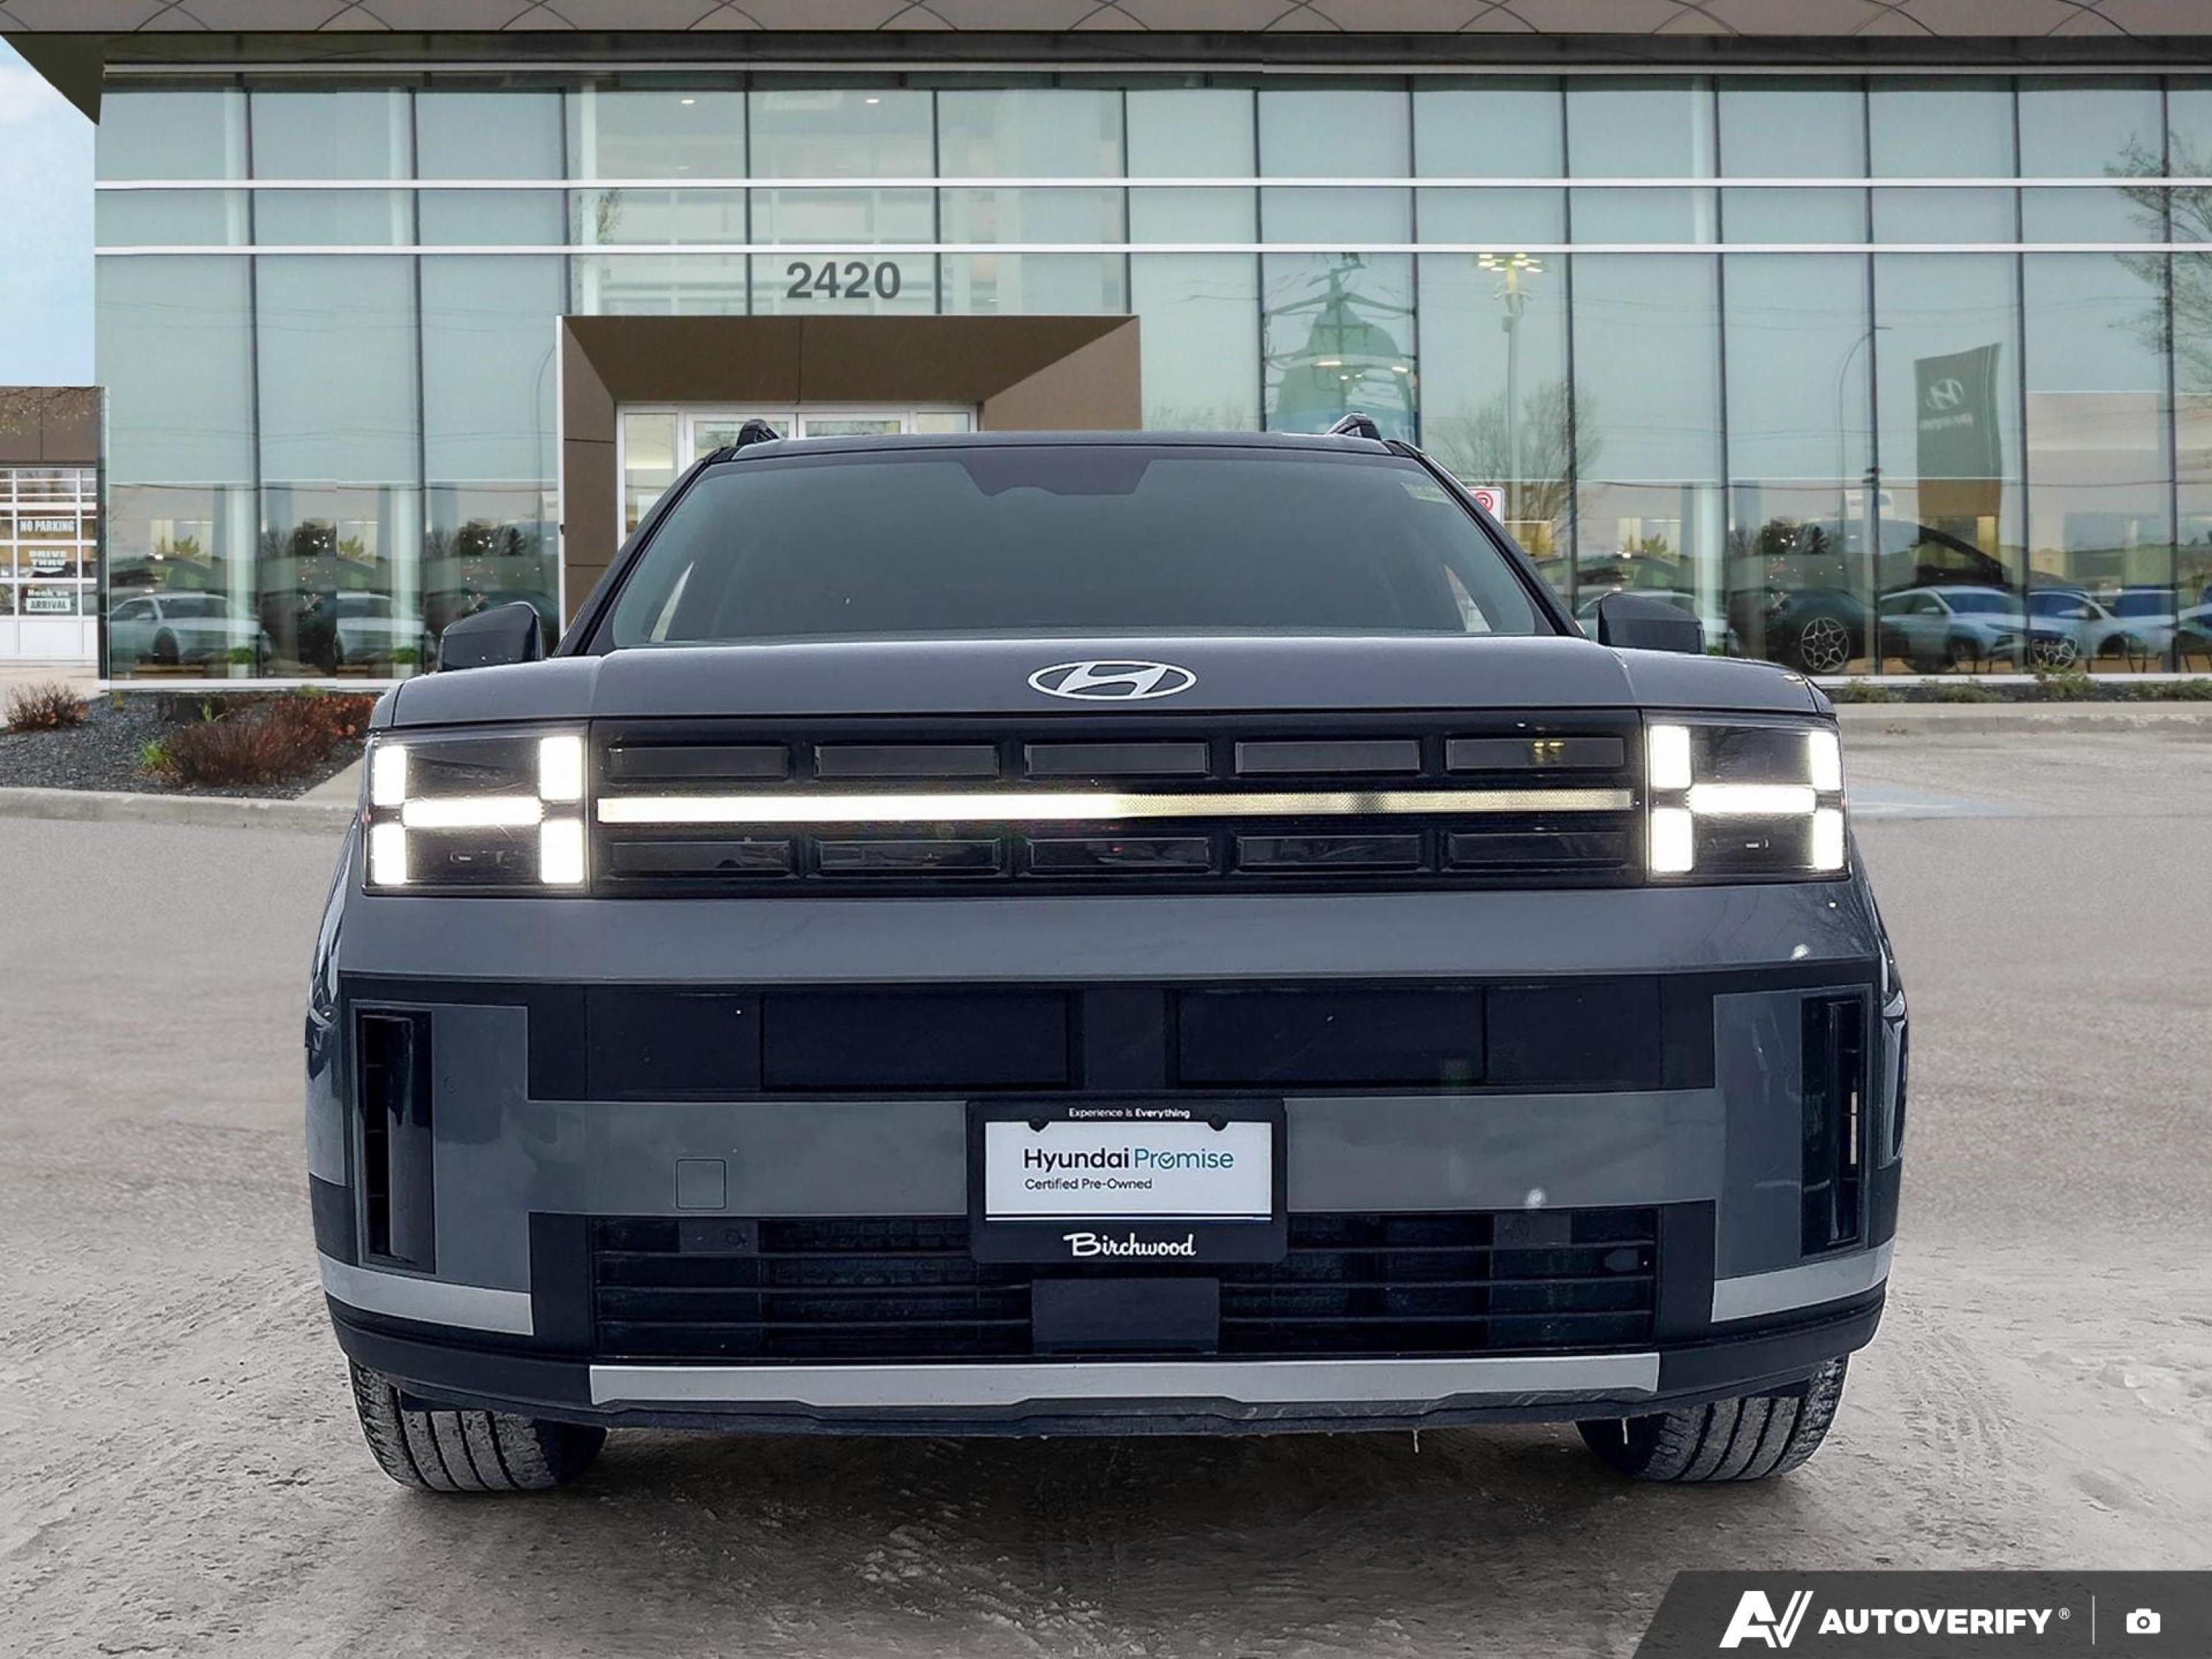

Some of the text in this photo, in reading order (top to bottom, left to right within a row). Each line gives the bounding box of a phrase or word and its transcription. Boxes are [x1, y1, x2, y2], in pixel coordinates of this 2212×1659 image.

[786, 261, 901, 299] 2420
[20, 520, 74, 532] NO PARKING
[30, 600, 67, 609] ARRIVAL
[1069, 1107, 1123, 1119] Experience
[1135, 1107, 1191, 1119] Everything
[1024, 1147, 1234, 1172] Hyundai Promise
[1024, 1178, 1152, 1190] Certified Pre-Owned
[1063, 1232, 1196, 1256] Birchwood
